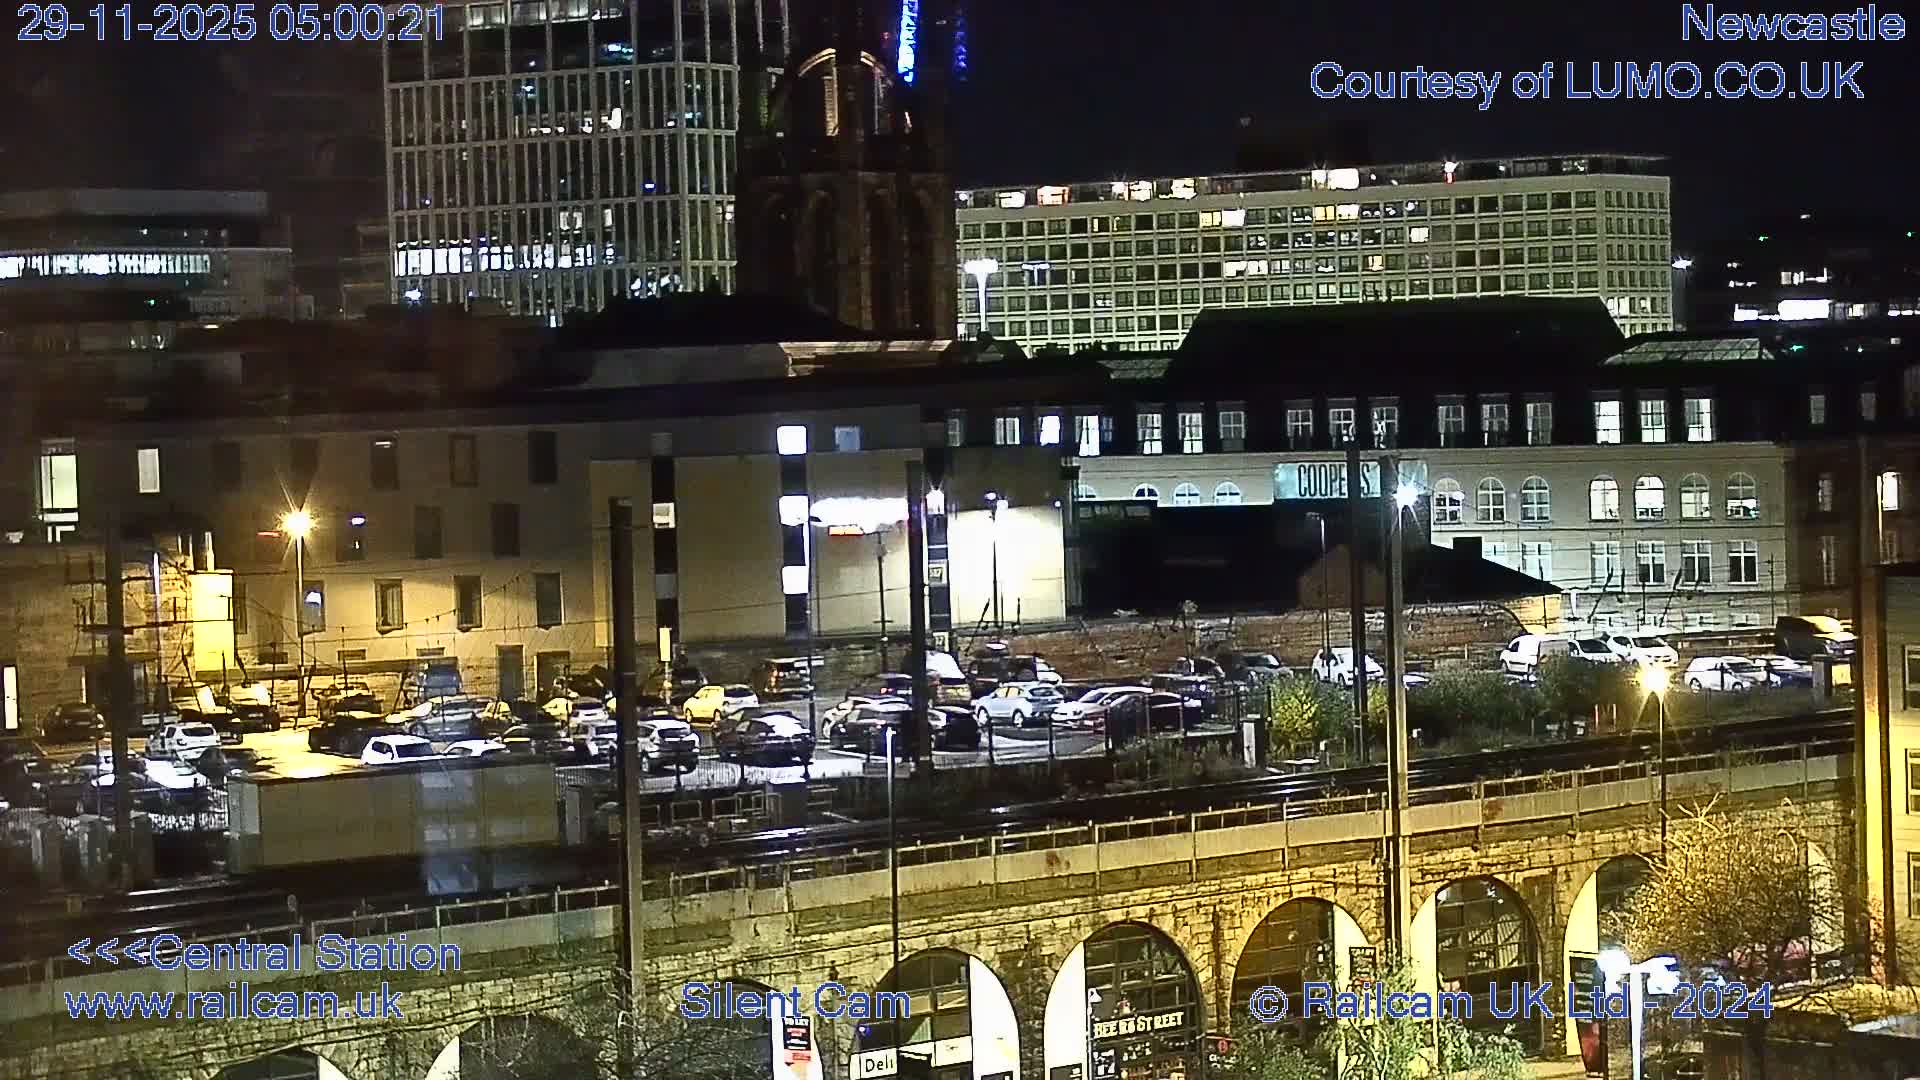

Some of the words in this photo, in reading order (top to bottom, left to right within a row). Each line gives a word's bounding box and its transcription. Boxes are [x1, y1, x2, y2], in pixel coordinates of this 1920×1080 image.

[1298, 463, 1370, 497] COOPES
[1136, 1012, 1184, 1032] STREET
[865, 1055, 894, 1073] Deli
